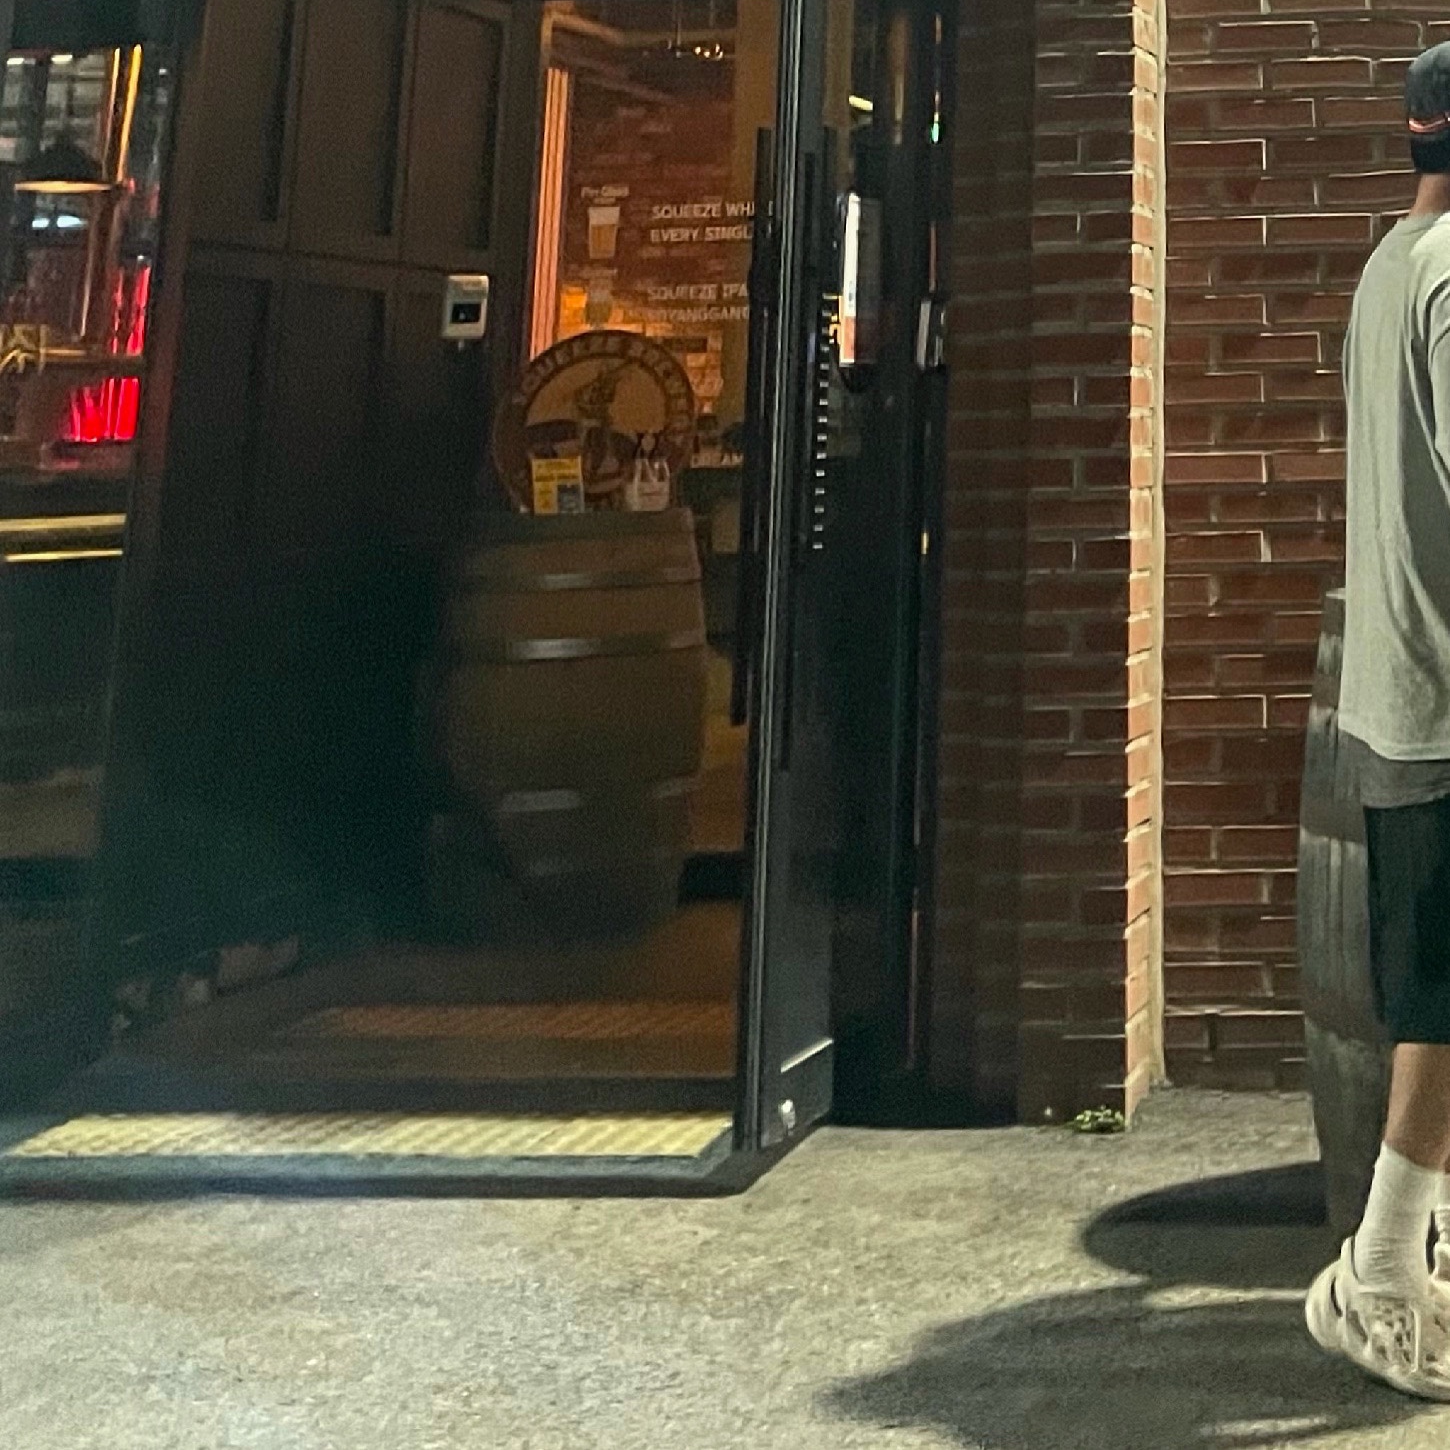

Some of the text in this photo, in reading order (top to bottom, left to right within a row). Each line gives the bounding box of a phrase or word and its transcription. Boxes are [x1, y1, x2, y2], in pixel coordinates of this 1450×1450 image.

[651, 203, 722, 218] SQUEEZE
[650, 223, 754, 242] EVERY SINGL
